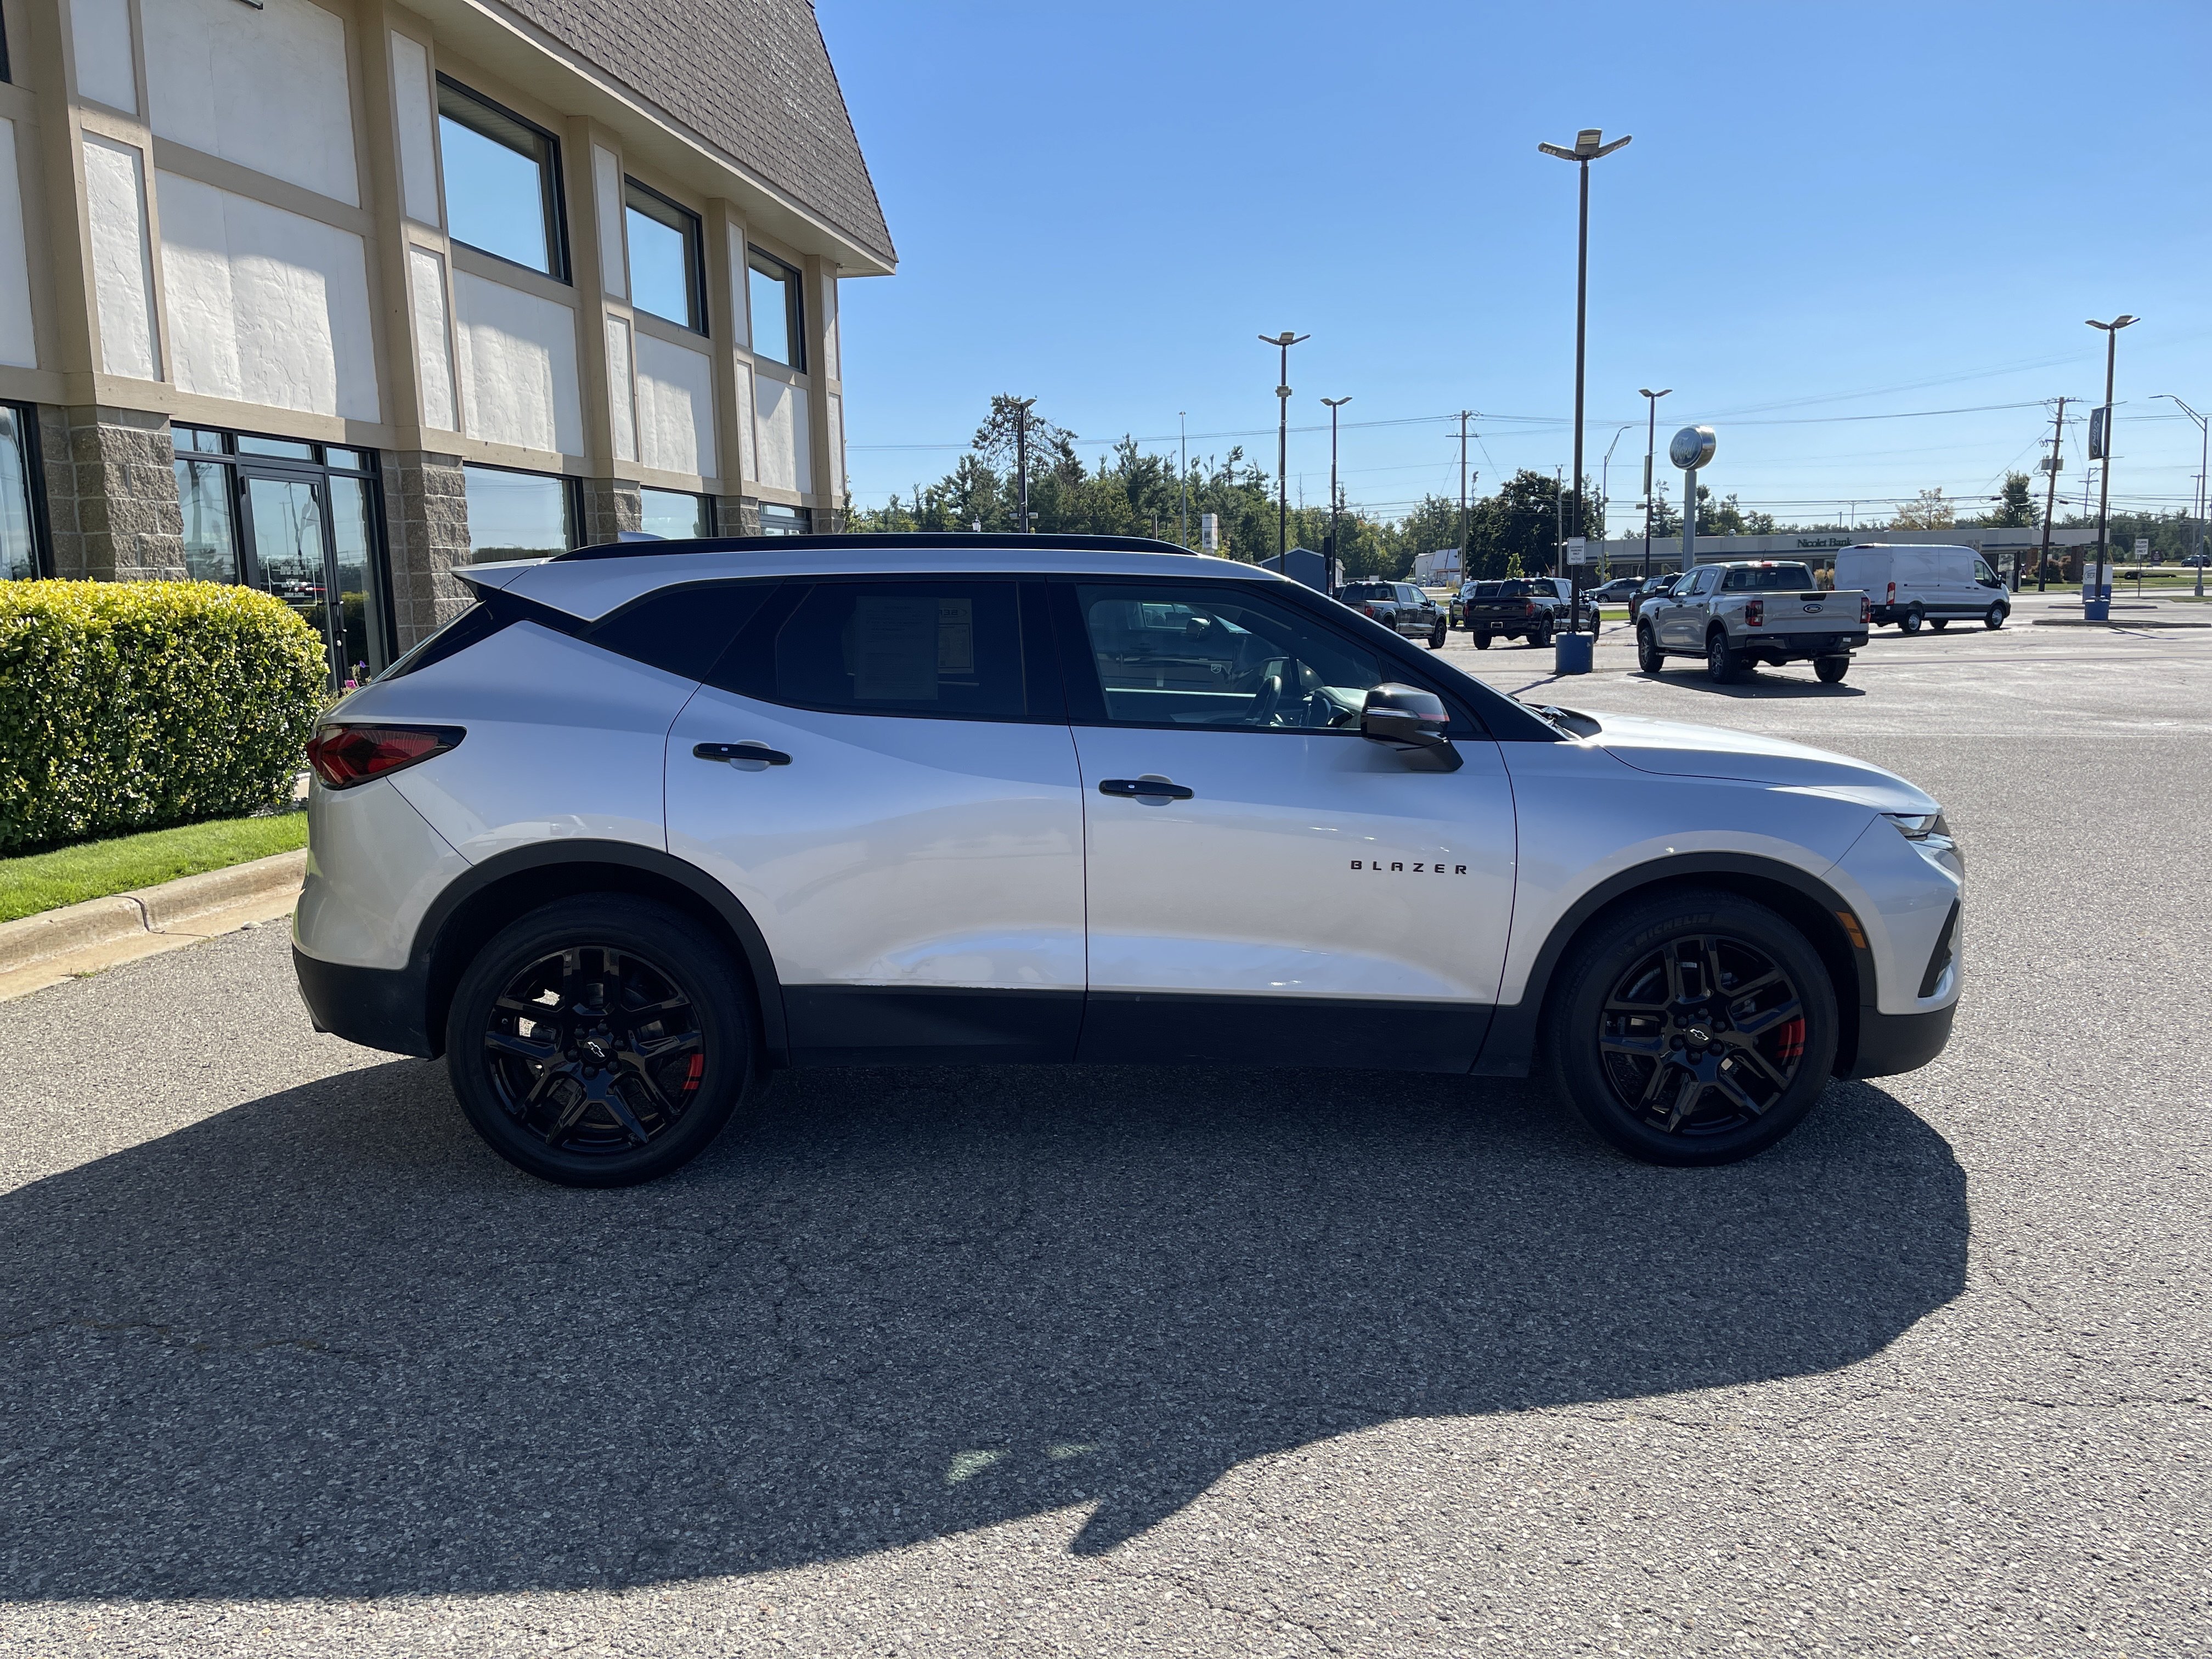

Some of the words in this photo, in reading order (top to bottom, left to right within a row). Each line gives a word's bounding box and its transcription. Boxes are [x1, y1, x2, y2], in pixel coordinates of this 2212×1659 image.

[1674, 437, 1694, 461] Ford
[1797, 539, 1826, 548] Nicolet
[1829, 537, 1853, 547] Bank
[1351, 860, 1467, 874] BLAZER
[1635, 913, 1711, 946] MICHELIN
